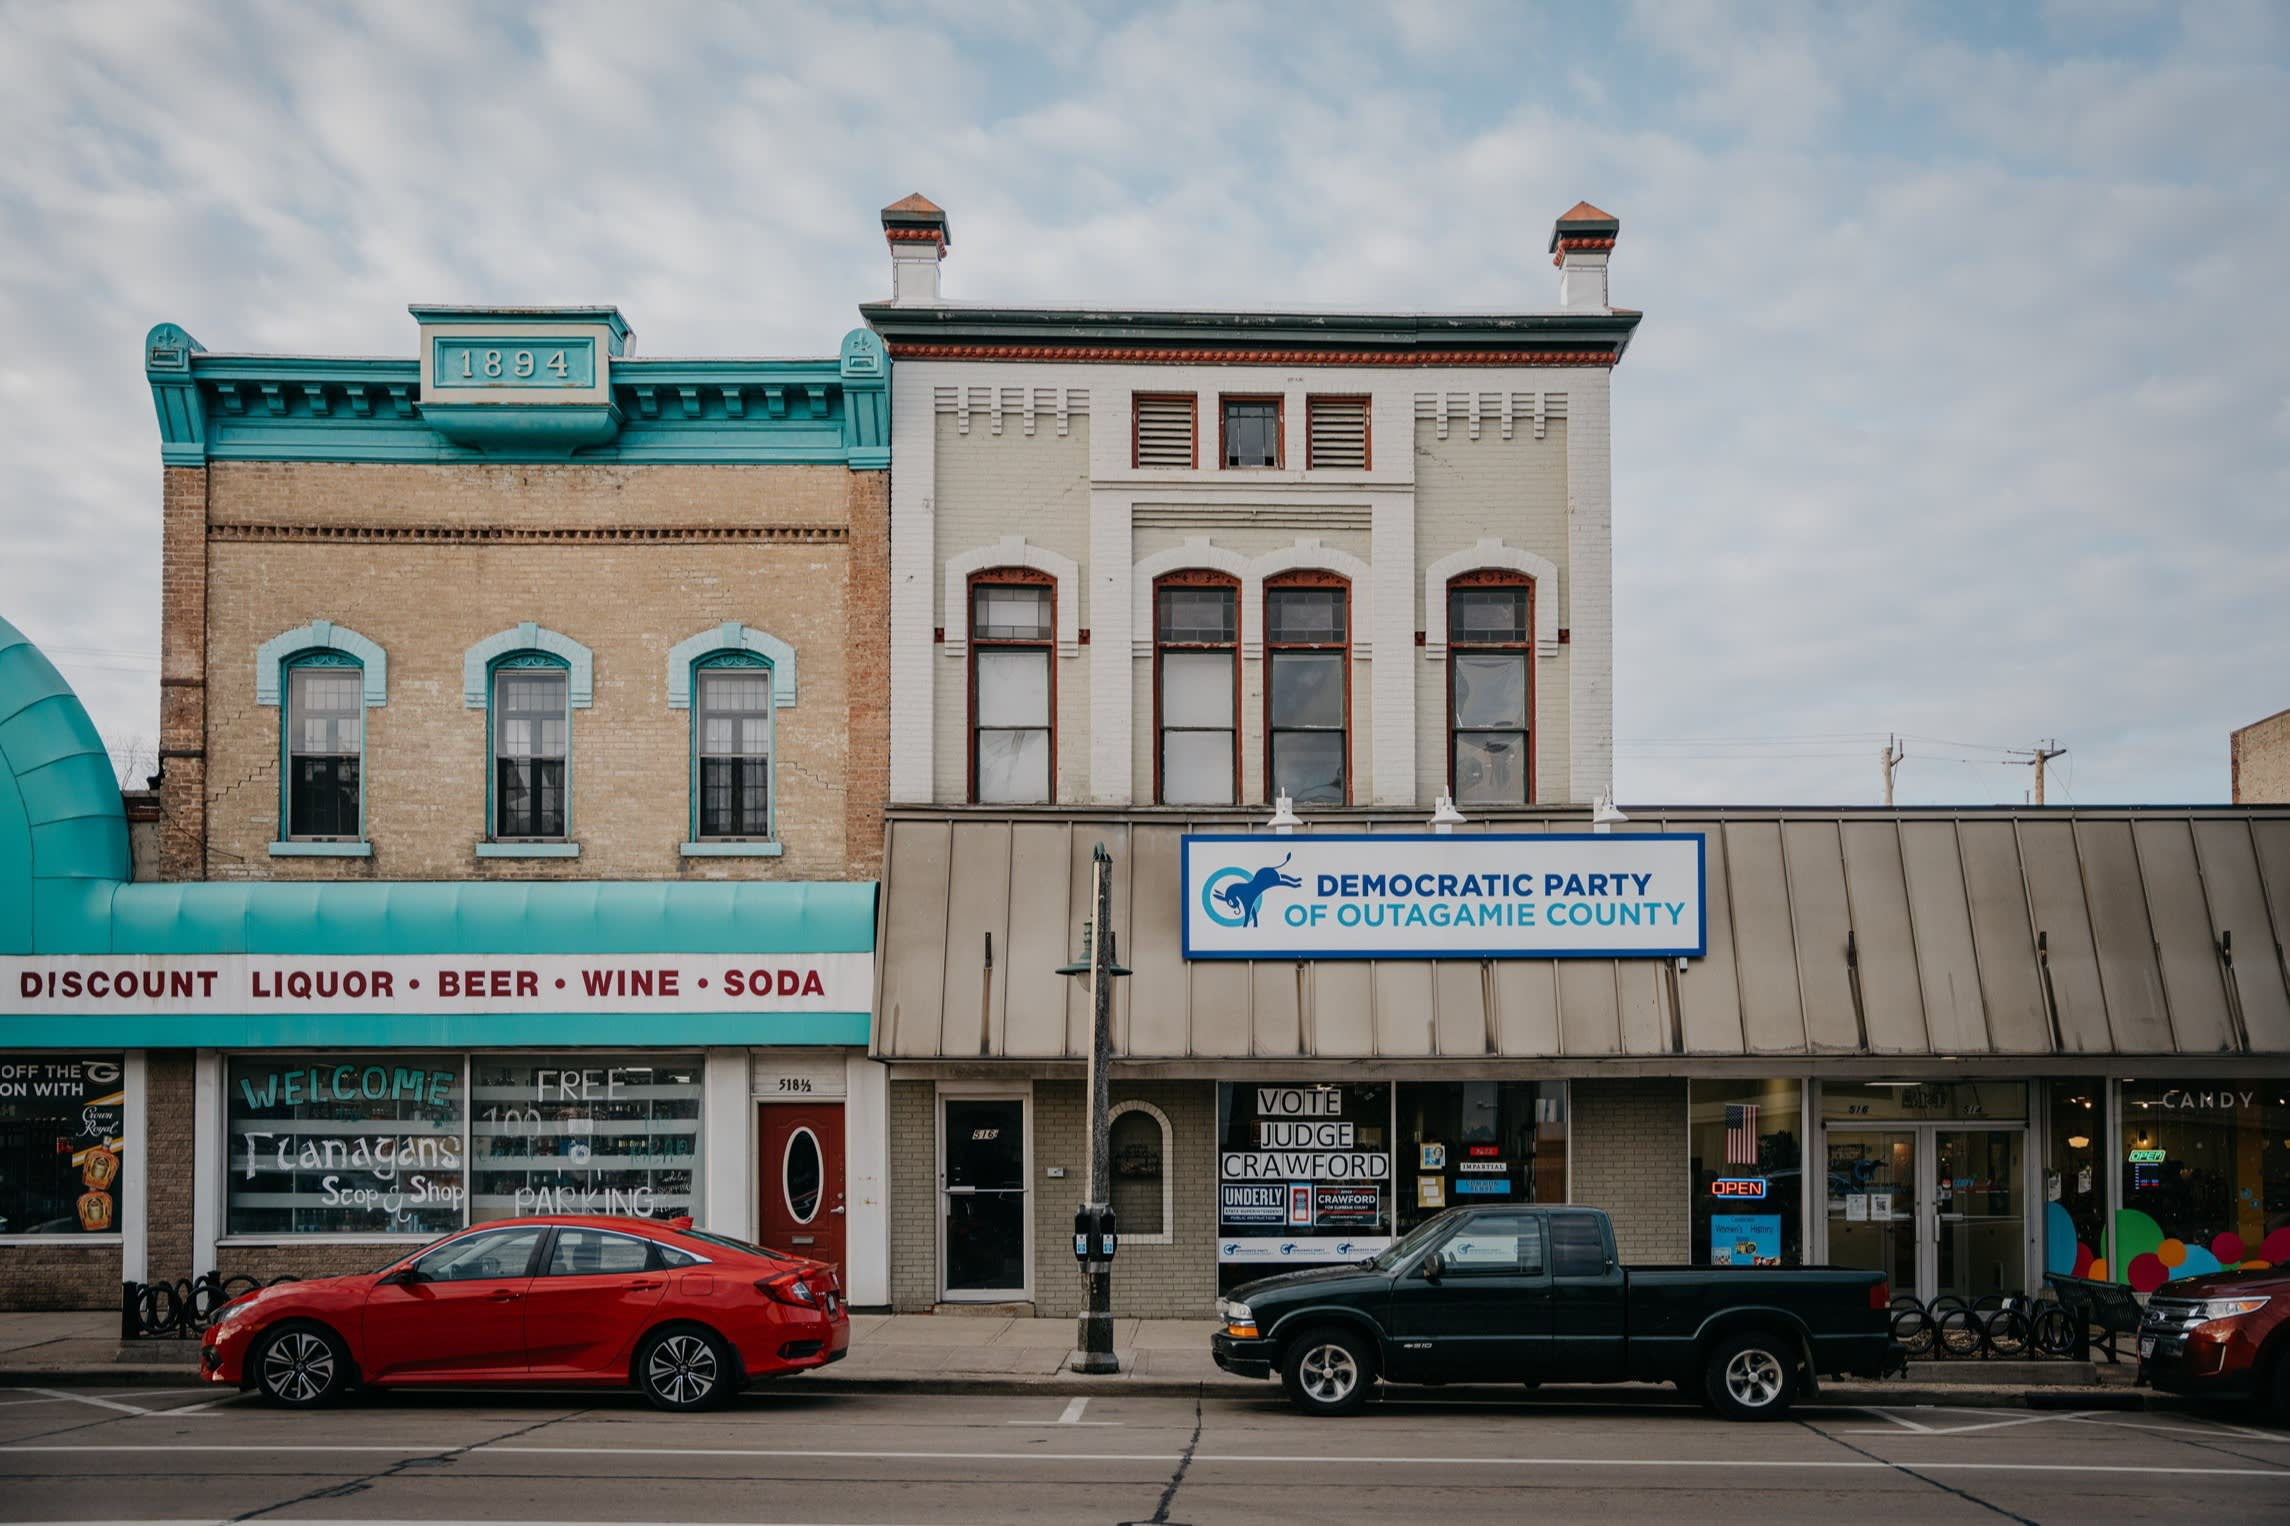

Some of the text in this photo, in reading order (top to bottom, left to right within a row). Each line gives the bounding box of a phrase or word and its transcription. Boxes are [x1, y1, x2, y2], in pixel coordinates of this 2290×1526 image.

[461, 349, 568, 378] 1894
[1317, 873, 1652, 898] DEMOCRATIC PARTY
[1284, 901, 1686, 928] OF OUTAGAMIE COUNTY
[20, 969, 825, 1000] DISCOUNT LIQUOR BEER WINE SODA
[1, 1064, 81, 1078] OFF THE
[33, 1082, 84, 1097] WITH
[239, 1064, 456, 1110] WELCOME
[537, 1069, 628, 1103] FREE
[1260, 1090, 1340, 1114] VOTE
[2162, 1091, 2254, 1109] CANDY
[82, 1106, 113, 1121] Crown
[76, 1119, 119, 1137] Royal
[1262, 1124, 1352, 1147] JUDGE
[1223, 1154, 1388, 1178] CRAWFORD
[2131, 1151, 2163, 1161] OPEN
[321, 1175, 378, 1212] Stop
[409, 1175, 464, 1211] Shop
[1225, 1188, 1283, 1205] UNDERLY
[1318, 1194, 1376, 1204] CRAWFORD
[1711, 1181, 1762, 1195] OPEN
[514, 1186, 654, 1217] PARKING
